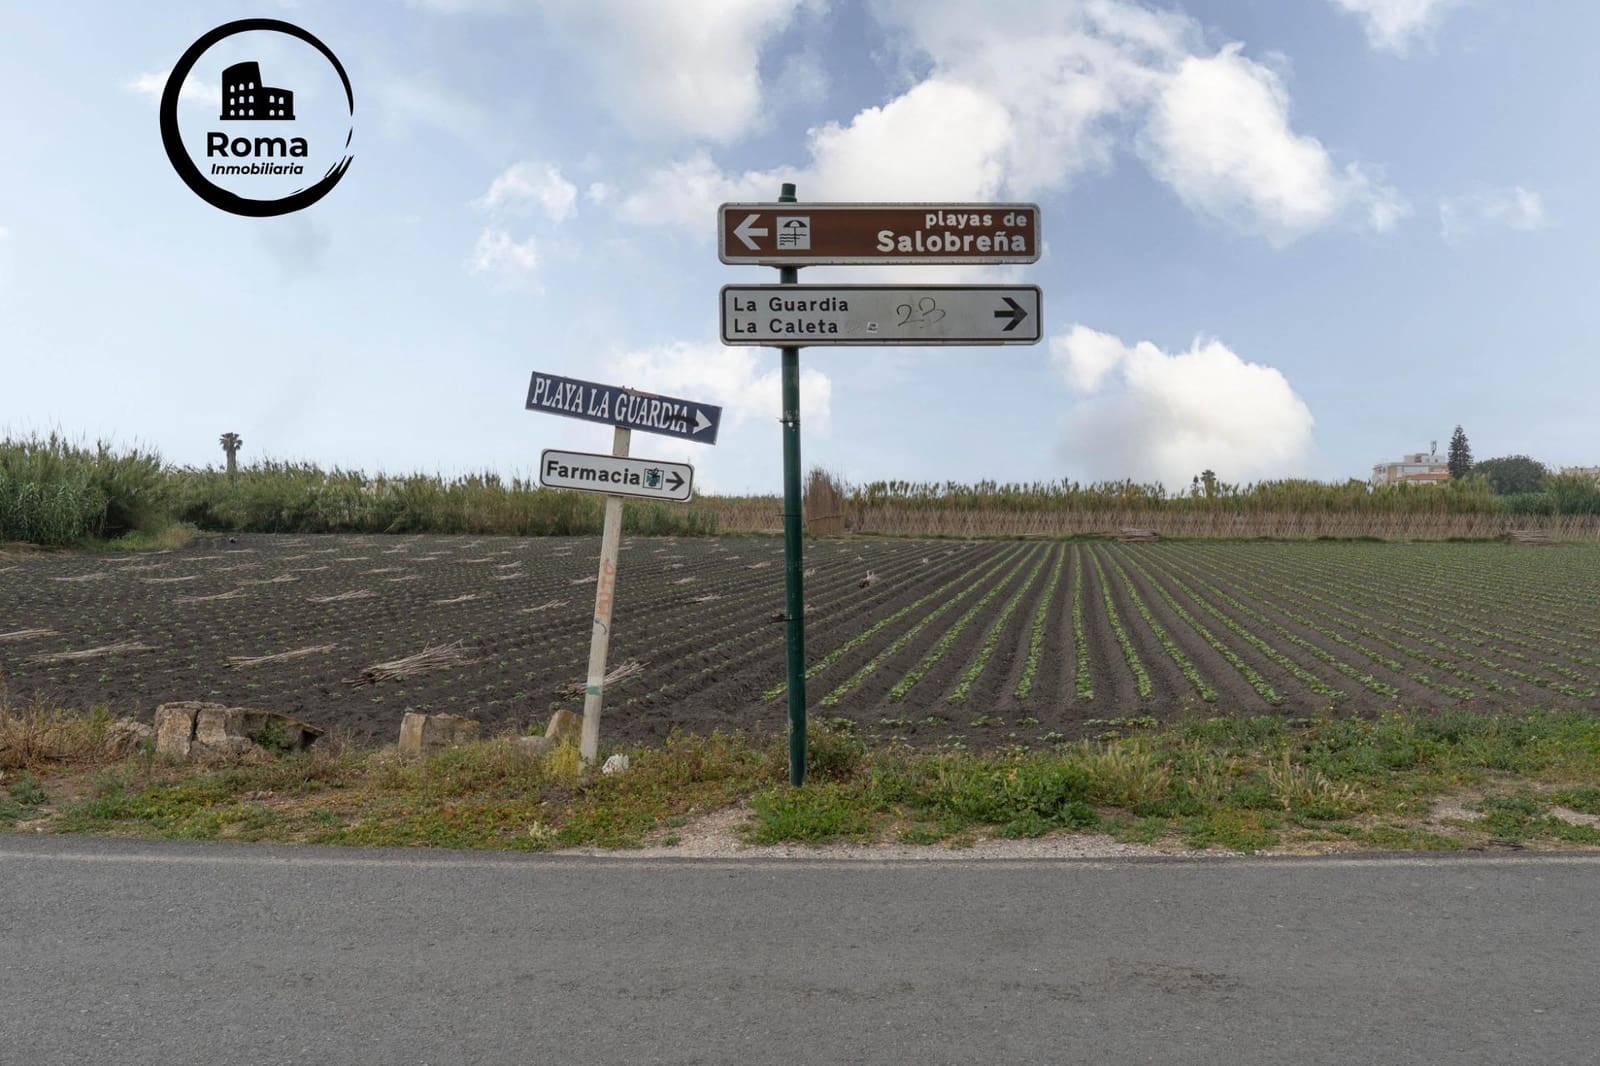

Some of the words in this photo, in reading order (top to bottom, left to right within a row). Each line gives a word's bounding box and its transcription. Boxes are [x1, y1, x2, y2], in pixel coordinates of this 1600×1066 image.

[925, 211, 992, 229] playas
[1003, 212, 1027, 227] de
[876, 230, 1026, 253] Salobreña
[734, 297, 757, 312] La
[769, 297, 849, 313] Guardia
[734, 319, 757, 333] La
[769, 318, 838, 334] Caleta
[532, 377, 583, 414] PLAYA
[587, 388, 610, 419] LA
[614, 393, 688, 434] GUARDIA
[546, 460, 640, 486] Farmacia
